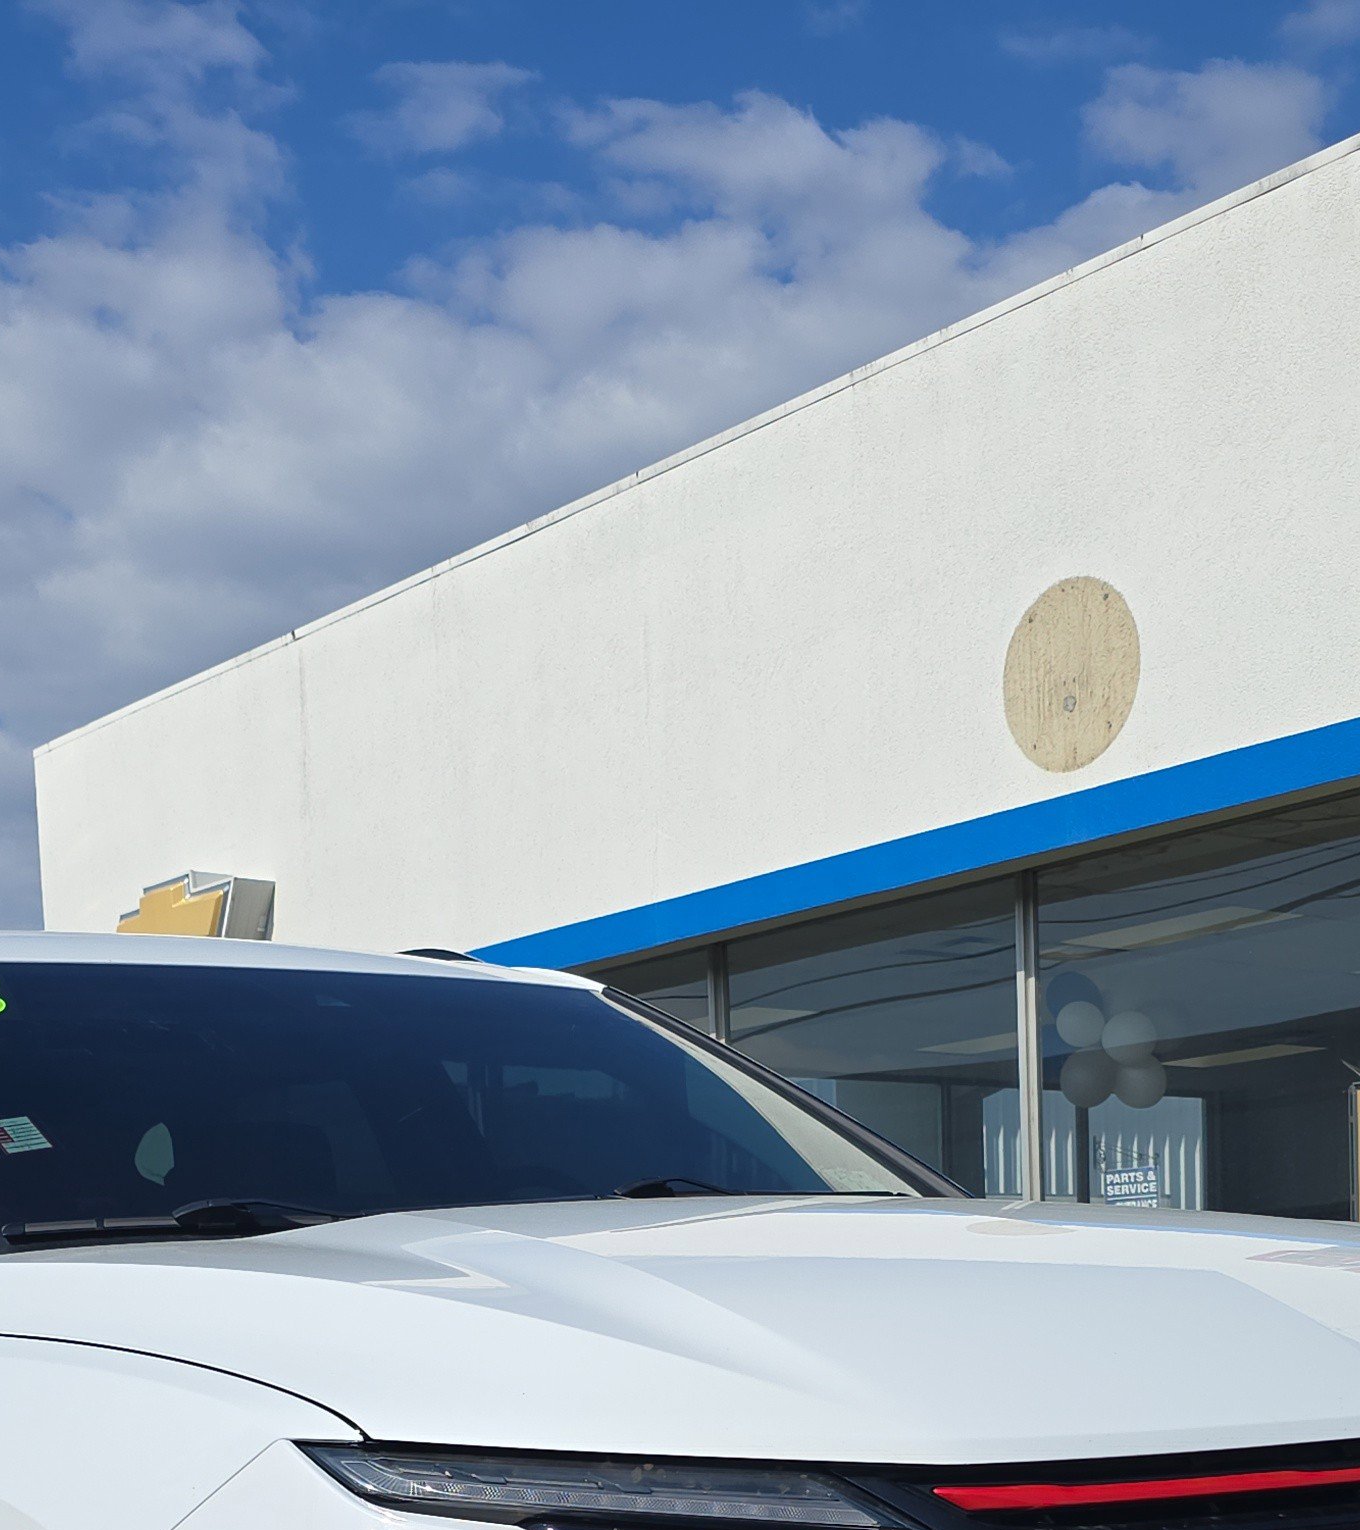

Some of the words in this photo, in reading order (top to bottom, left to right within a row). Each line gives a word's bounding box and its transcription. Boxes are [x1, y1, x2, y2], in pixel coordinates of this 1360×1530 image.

[1106, 1172, 1143, 1184] PARTS
[1147, 1171, 1156, 1180] &
[1107, 1182, 1157, 1196] SERVICE
